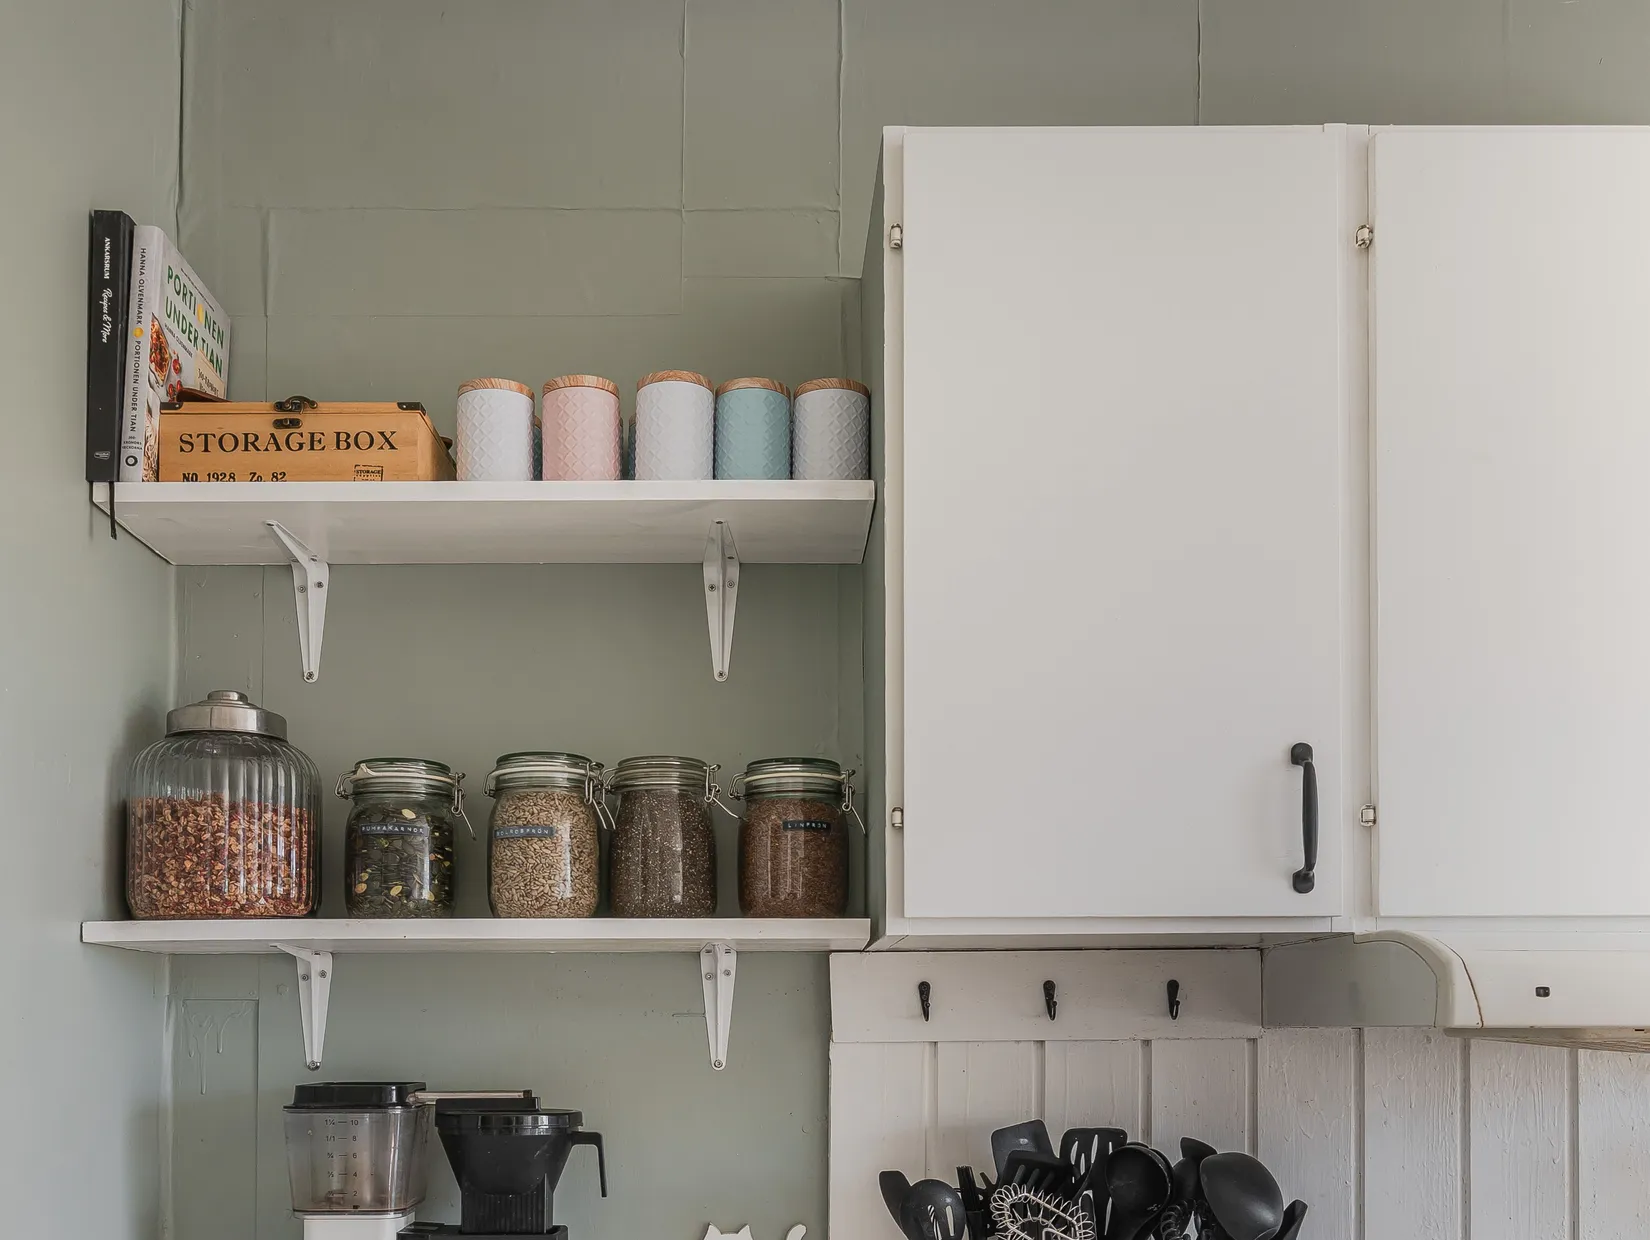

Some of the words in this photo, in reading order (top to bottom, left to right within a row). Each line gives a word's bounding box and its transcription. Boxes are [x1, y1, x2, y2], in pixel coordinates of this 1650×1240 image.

[103, 237, 111, 280] ANKARSRUM
[138, 247, 146, 276] HANNA
[99, 287, 113, 313] Recipes
[136, 279, 145, 324] OLVENMARK
[100, 321, 112, 343] More
[165, 295, 199, 351] UNDER
[201, 337, 223, 378] TIAN
[131, 340, 141, 384] PORTIONEN
[131, 387, 139, 411] UNDER
[130, 414, 138, 432] TIAN
[179, 431, 326, 453] STORAGE
[333, 430, 399, 451] BOX
[206, 472, 236, 482] 1928
[270, 471, 287, 482] 82
